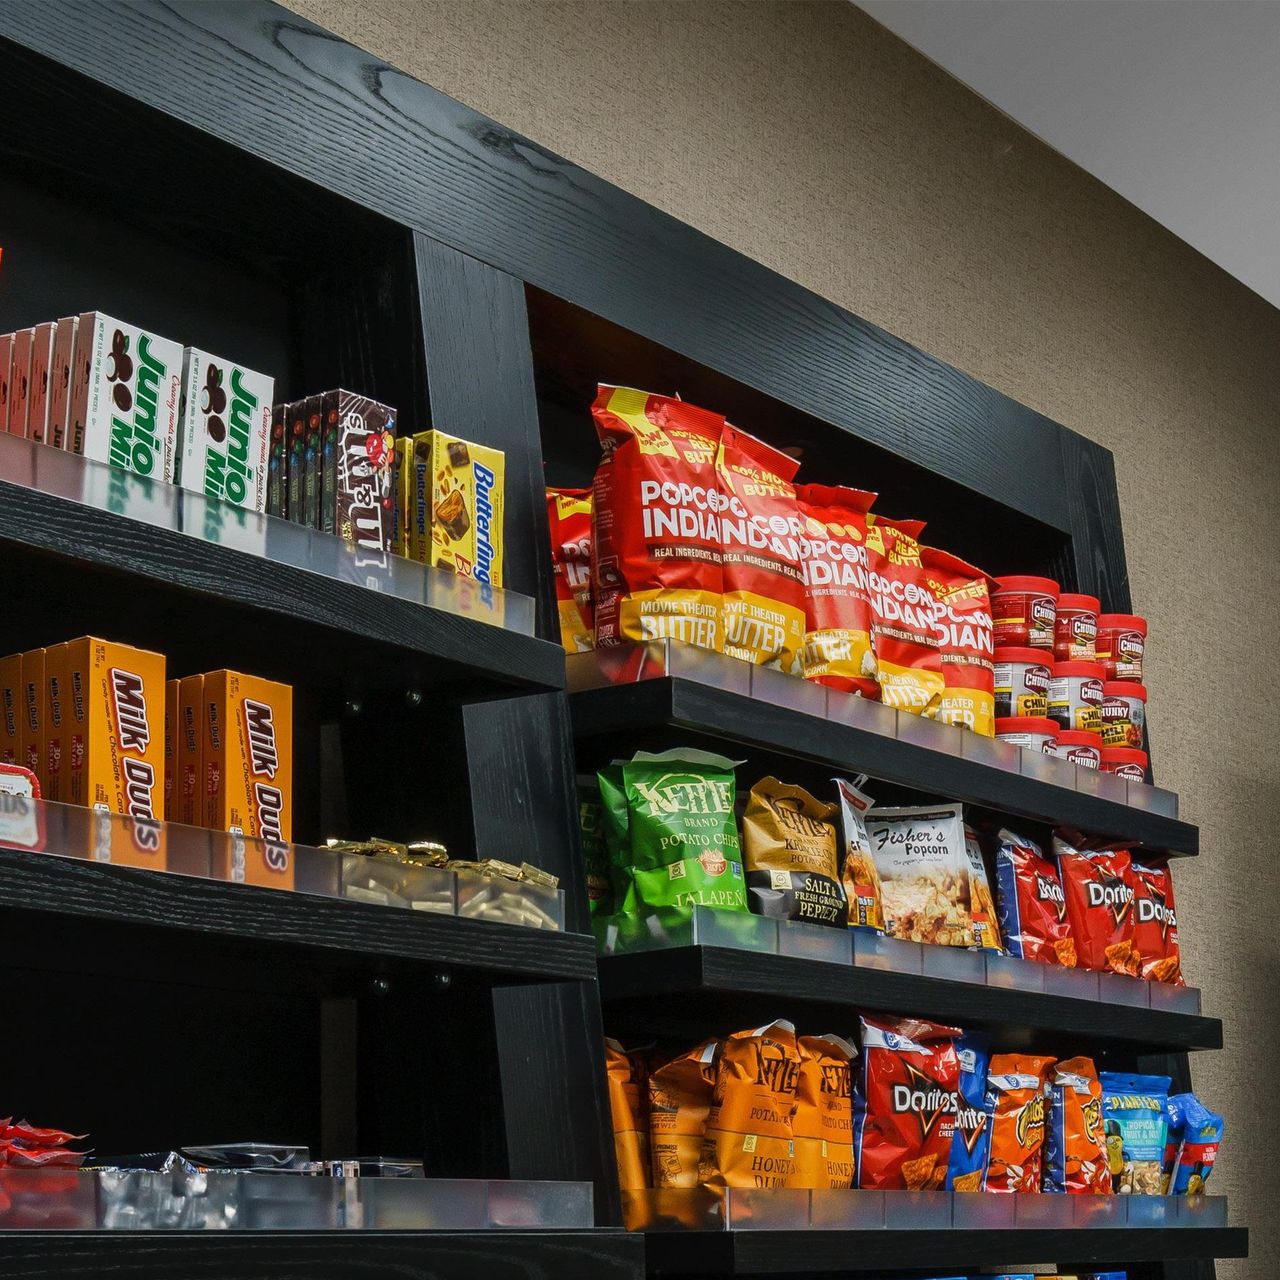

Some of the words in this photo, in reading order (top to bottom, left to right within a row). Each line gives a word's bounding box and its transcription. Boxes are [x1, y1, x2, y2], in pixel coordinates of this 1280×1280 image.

[654, 547, 675, 558] REAL
[640, 600, 679, 613] MOVIE
[682, 601, 717, 616] THEATER
[750, 606, 786, 626] THEATER
[640, 615, 717, 649] BUTTER
[109, 668, 150, 754] Milk
[242, 697, 278, 779] Milk
[243, 761, 252, 806] Chocolate
[122, 756, 160, 851] Duds
[632, 776, 733, 819] KETTLE
[254, 782, 289, 871] Duds
[684, 817, 719, 829] BRAND
[660, 833, 710, 851] POTATO
[713, 835, 739, 850] CHIPS
[872, 826, 947, 851] Fisher's
[905, 842, 949, 857] Popcorn
[805, 878, 831, 893] SALT
[794, 891, 818, 903] FRESH
[818, 893, 844, 910] GROUND
[799, 901, 838, 923] PEPPER
[894, 1085, 958, 1113] Doritos
[752, 1156, 791, 1175] HONEY
[827, 1160, 855, 1177] HONEY
